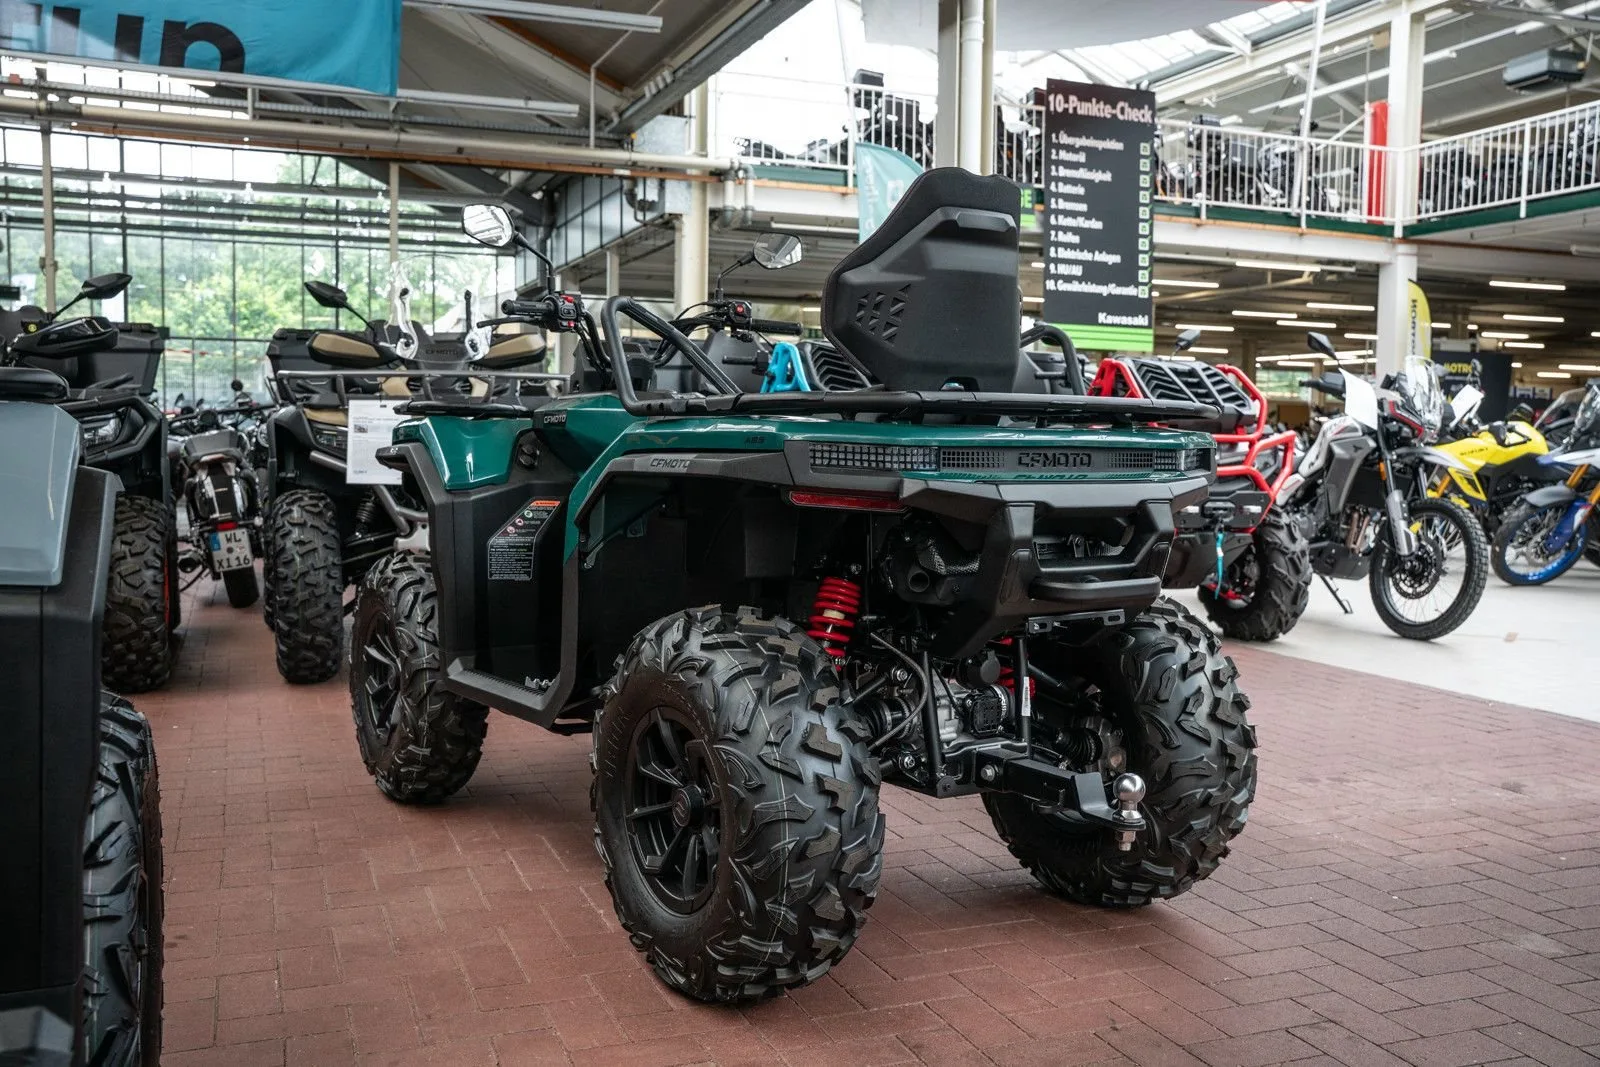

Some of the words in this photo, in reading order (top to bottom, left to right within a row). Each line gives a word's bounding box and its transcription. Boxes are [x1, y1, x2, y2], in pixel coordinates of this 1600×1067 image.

[1048, 93, 1153, 124] 10-Punkte-Check
[1051, 148, 1058, 160] 2.
[1059, 149, 1086, 163] Motoröl
[1050, 181, 1057, 192] 4.
[1058, 181, 1085, 195] Batterie
[1050, 197, 1057, 209] 5.
[1058, 198, 1088, 212] Bremsen
[1050, 214, 1057, 225] 6.
[1050, 230, 1057, 241] 7.
[1057, 230, 1080, 244] Reifen
[1049, 246, 1057, 258] 8.
[1049, 263, 1057, 274] 9.
[1057, 263, 1083, 276] HU/AU
[1045, 279, 1057, 291] 10.
[1098, 312, 1149, 327] Kawasaki
[543, 414, 567, 424] CFMOTO
[1018, 452, 1092, 468] CFMOTO
[225, 531, 242, 543] WL
[235, 555, 250, 567] 16
